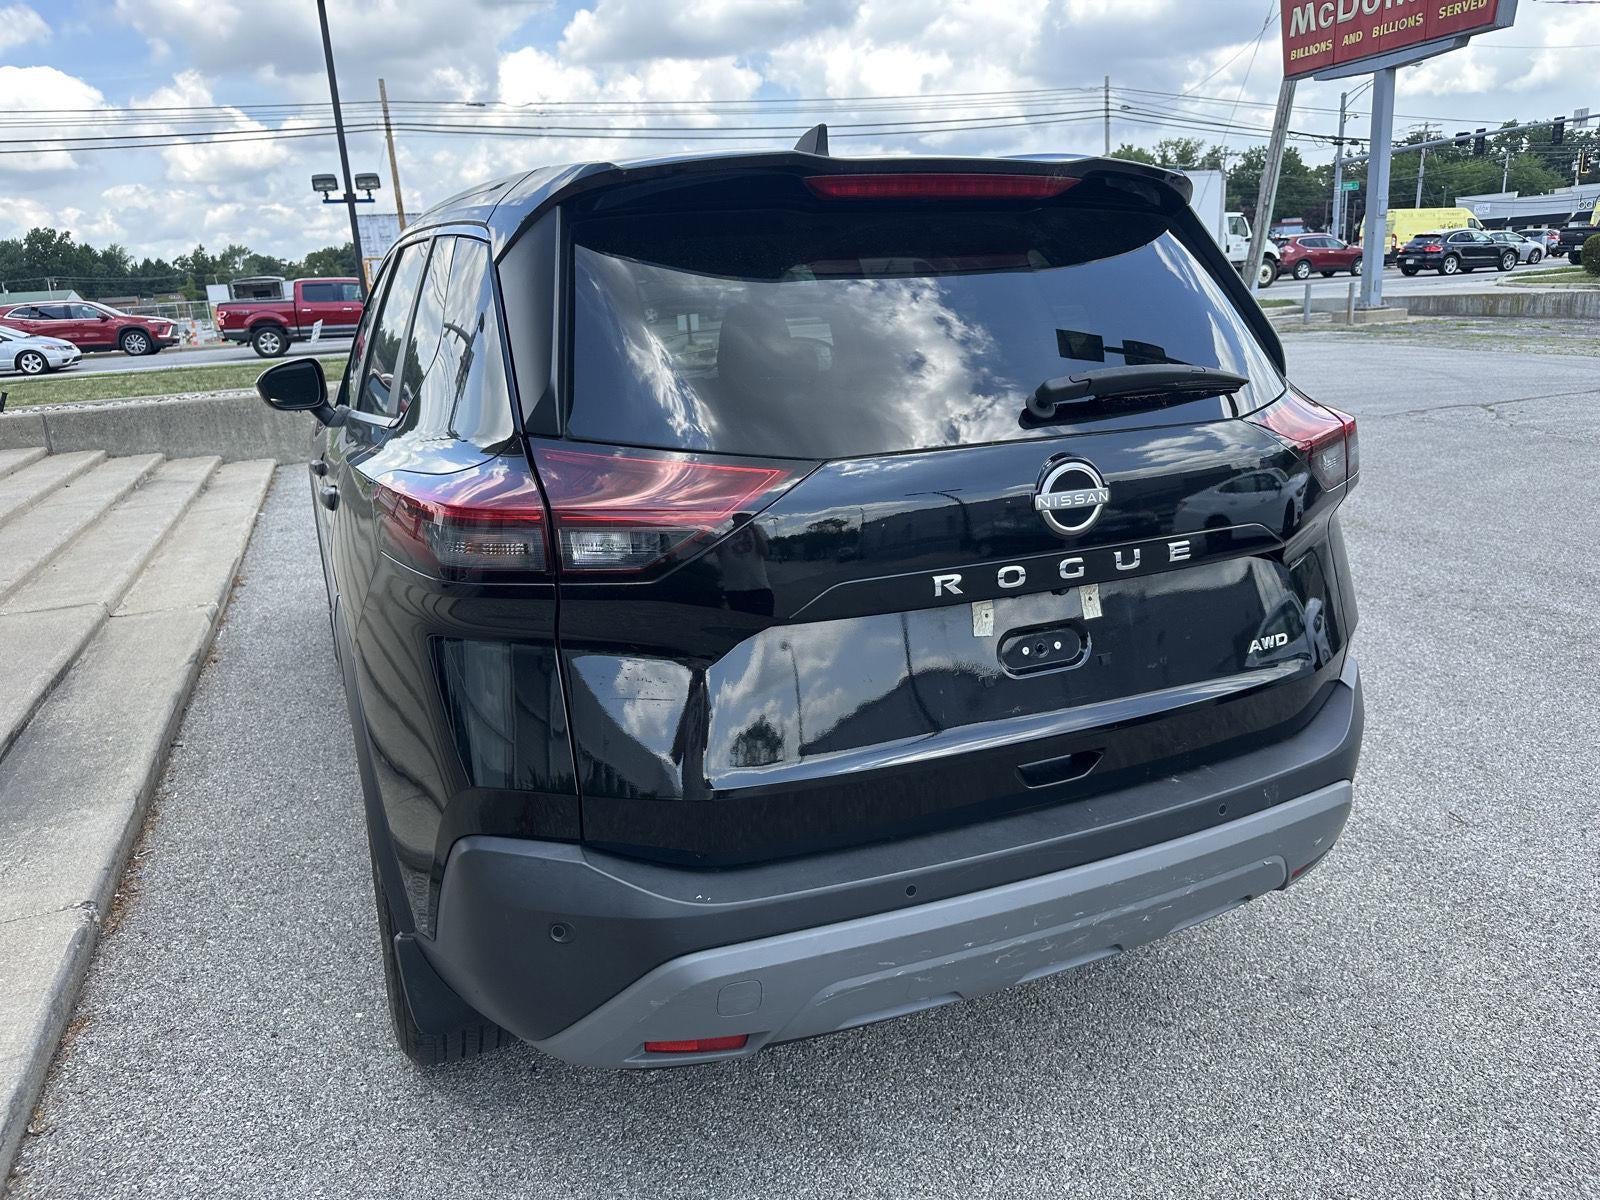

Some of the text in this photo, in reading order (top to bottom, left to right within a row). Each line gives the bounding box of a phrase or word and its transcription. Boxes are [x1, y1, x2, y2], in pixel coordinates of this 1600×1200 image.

[1290, 0, 1487, 60] BILLIONS AND BILLIONS SERVED
[1038, 491, 1108, 508] NISSAN
[932, 540, 1192, 597] ROGUE
[1249, 632, 1289, 654] AWD
